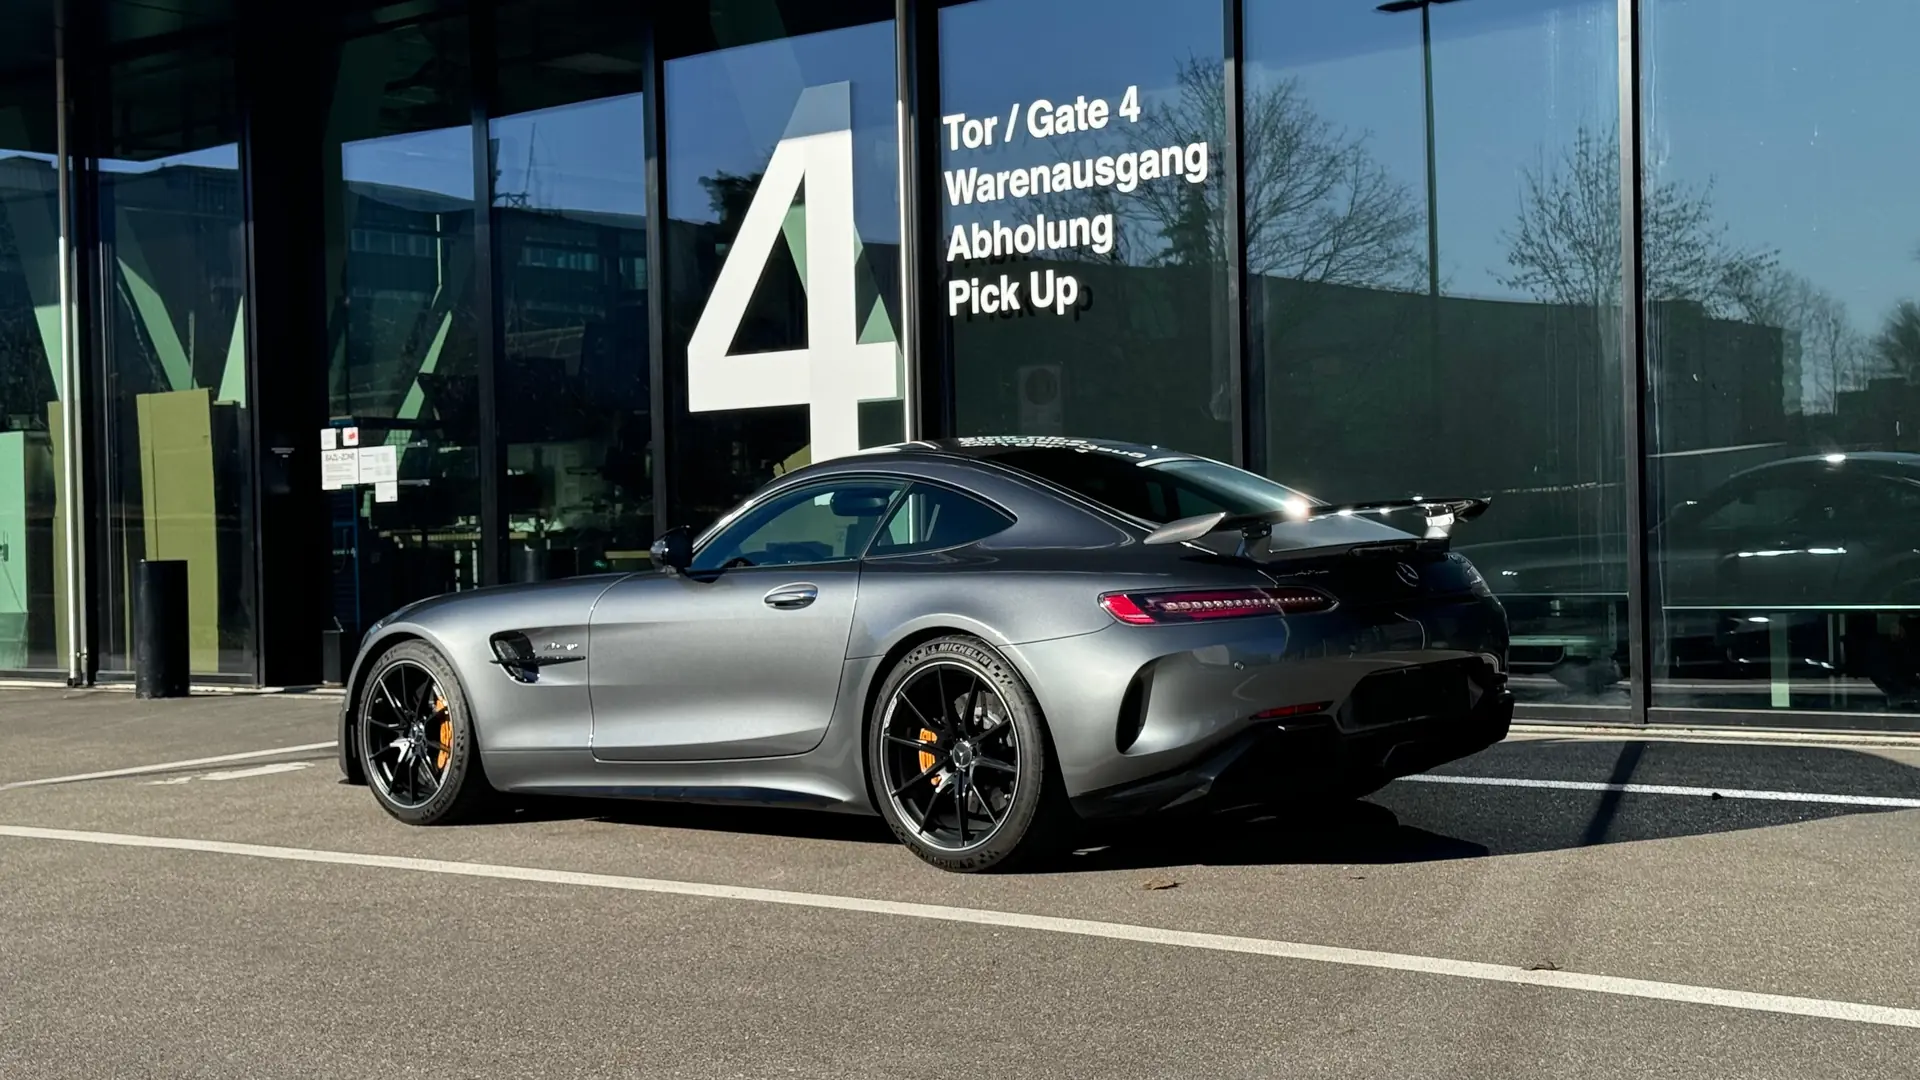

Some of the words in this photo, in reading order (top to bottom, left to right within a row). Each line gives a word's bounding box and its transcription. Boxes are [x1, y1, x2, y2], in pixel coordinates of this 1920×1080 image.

[943, 112, 998, 151] Tor
[1004, 103, 1020, 143] /
[1027, 95, 1109, 139] Gate
[1118, 85, 1141, 123] 4
[943, 140, 1208, 206] Warenausgang
[946, 213, 1114, 262] Abholung
[687, 80, 900, 462] 4
[948, 274, 1020, 317] Pick
[1030, 268, 1078, 316] Up
[938, 643, 991, 667] MICHELIN
